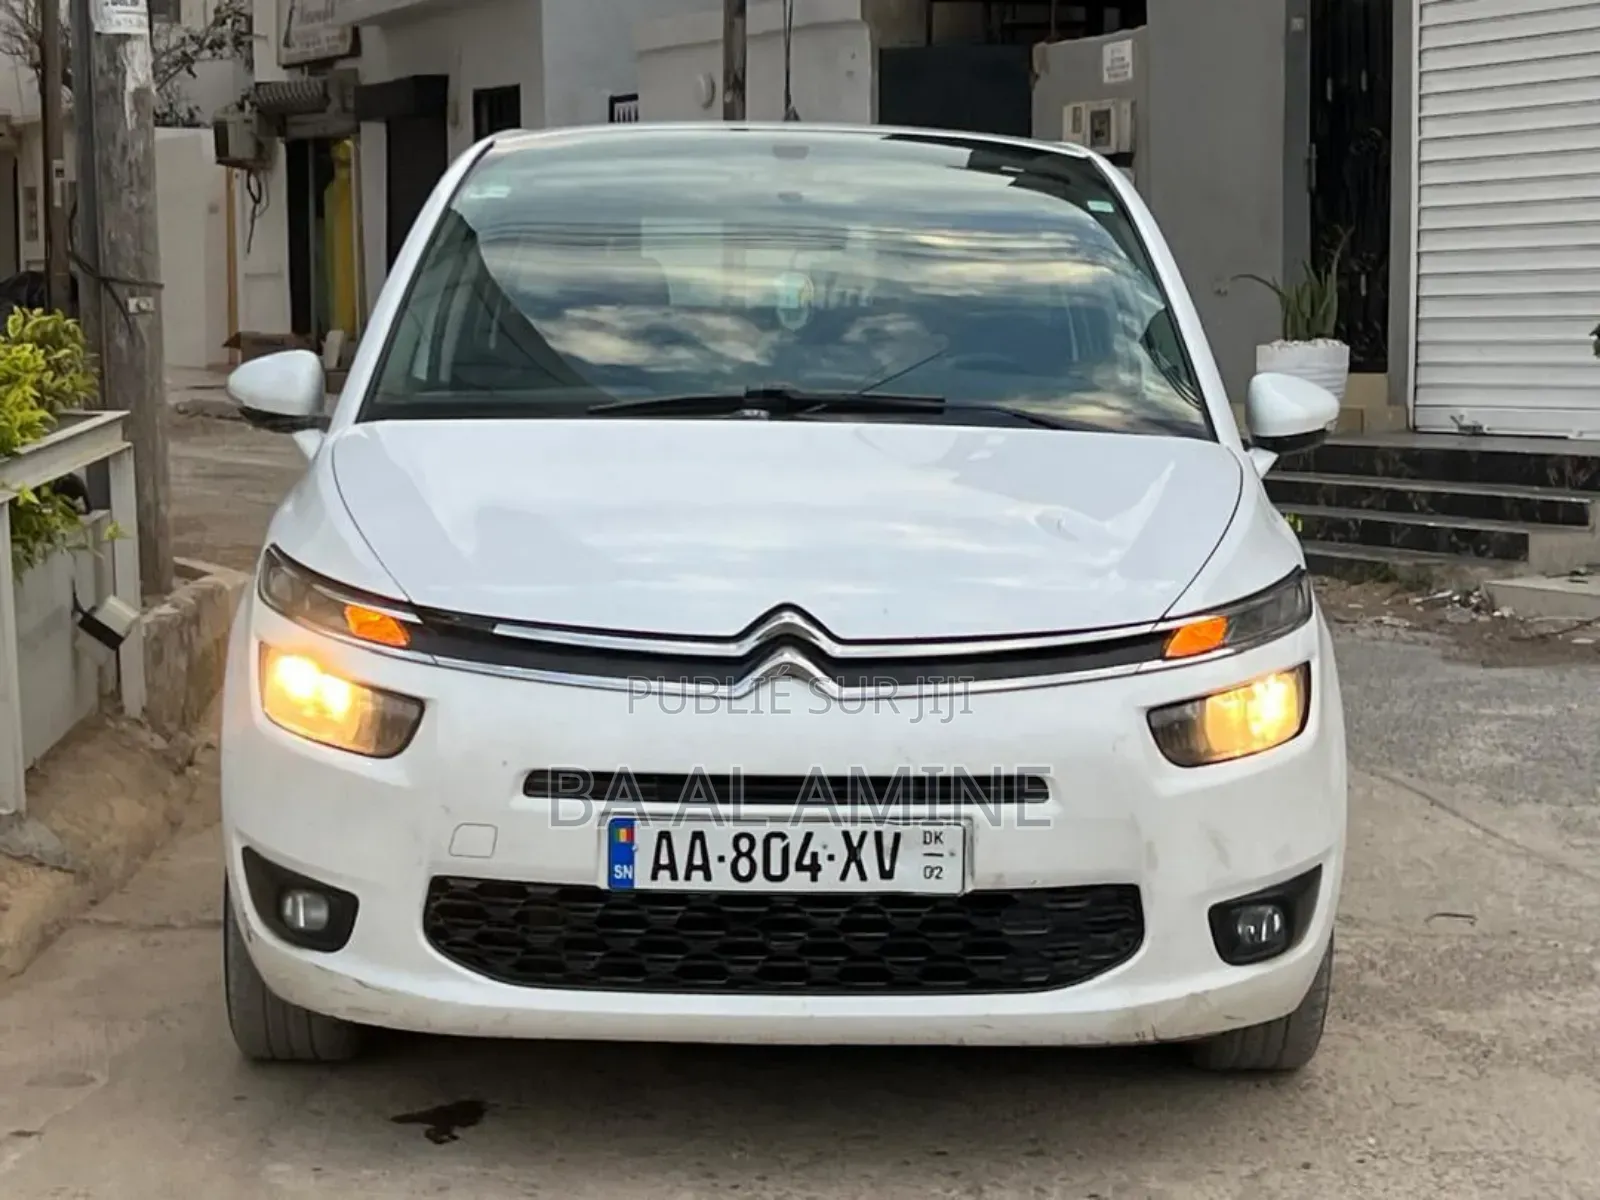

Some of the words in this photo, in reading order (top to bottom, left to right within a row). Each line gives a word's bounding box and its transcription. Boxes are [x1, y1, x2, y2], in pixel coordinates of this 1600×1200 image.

[923, 830, 944, 845] DK
[614, 864, 633, 880] SN
[923, 865, 943, 880] 02
